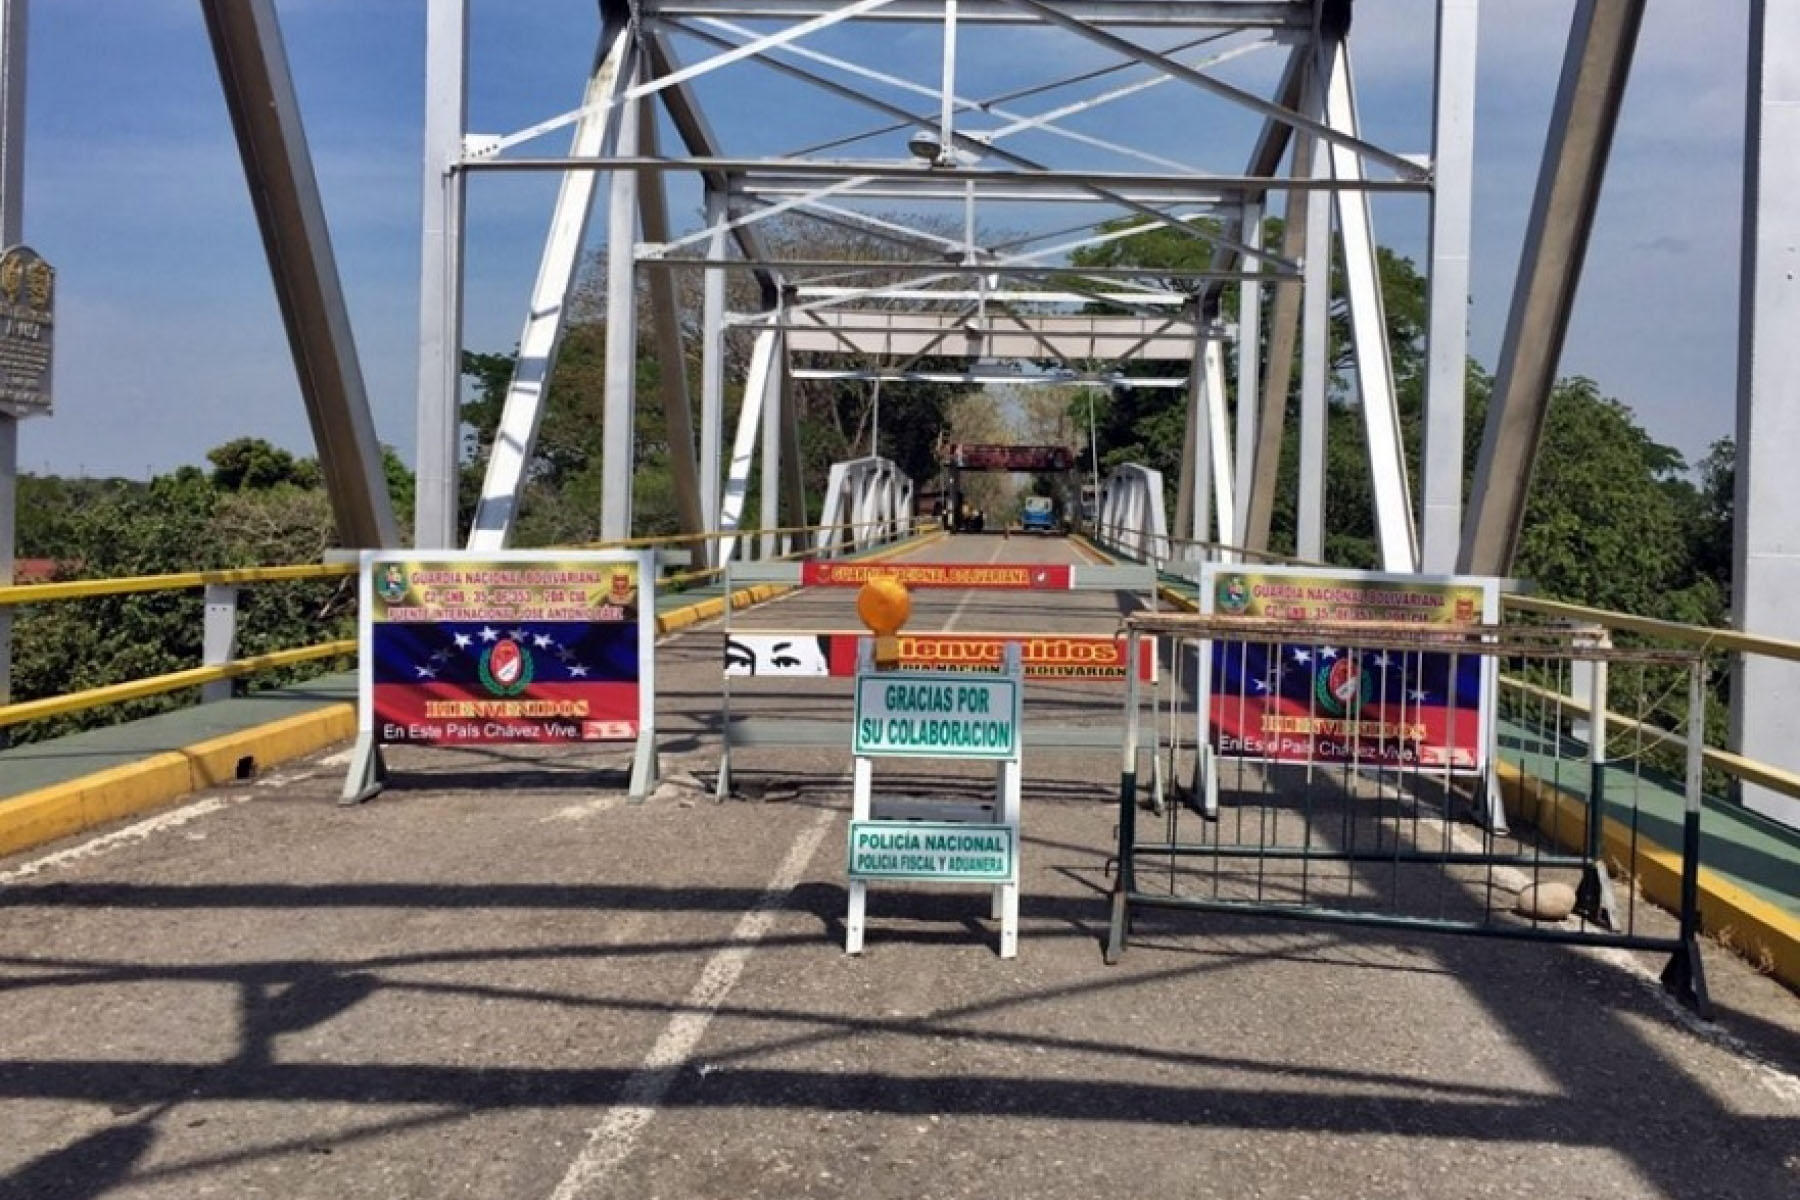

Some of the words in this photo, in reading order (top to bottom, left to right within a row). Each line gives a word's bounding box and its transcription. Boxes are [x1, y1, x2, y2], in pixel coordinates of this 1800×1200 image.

[411, 571, 462, 584] GUARDIA
[466, 571, 521, 584] NACIONAL
[525, 571, 601, 584] BOLIVARIANA
[1252, 584, 1304, 598] GUARDIA
[1307, 588, 1363, 603] NACIONAL
[1366, 590, 1445, 606] BOLIVARIANA
[885, 684, 953, 712] GRACIAS
[957, 686, 990, 713] POR
[384, 723, 405, 738] En
[408, 723, 442, 738] Este
[446, 722, 480, 738] País
[484, 721, 540, 738] Chávez
[861, 718, 883, 743] SU
[888, 718, 1010, 747] COLABORACION
[860, 831, 920, 849] POLICÍA
[926, 835, 1004, 852] NACIONAL
[858, 854, 898, 869] POLICIA
[901, 855, 937, 871] FISCAL
[939, 857, 946, 871] Y
[948, 856, 1003, 871] ADUANERA
